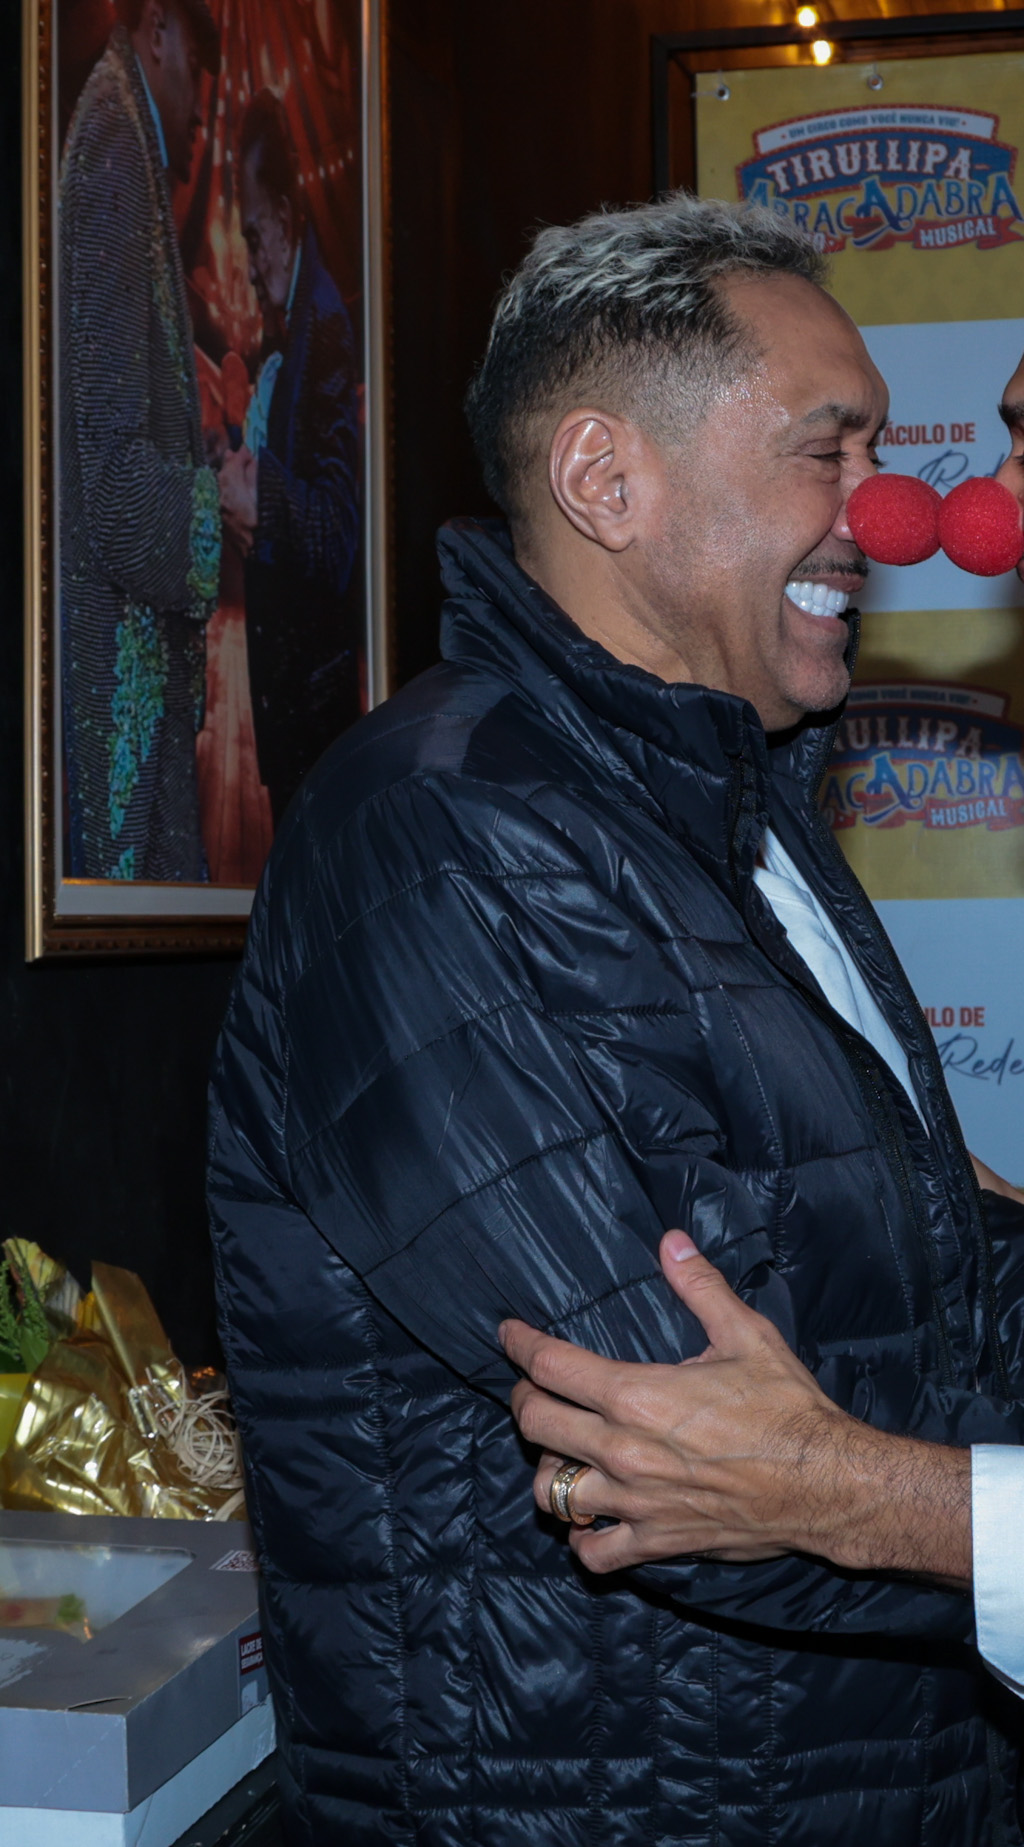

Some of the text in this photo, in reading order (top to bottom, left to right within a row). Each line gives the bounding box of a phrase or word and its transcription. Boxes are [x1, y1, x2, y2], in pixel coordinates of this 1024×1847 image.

[766, 139, 972, 193] TIRULLIPA
[919, 218, 997, 248] MUSICAL
[876, 421, 976, 446] ÁCULO DE
[835, 716, 984, 759] ULLIPA
[930, 800, 1007, 827] MUSICAL
[960, 1006, 985, 1027] DE
